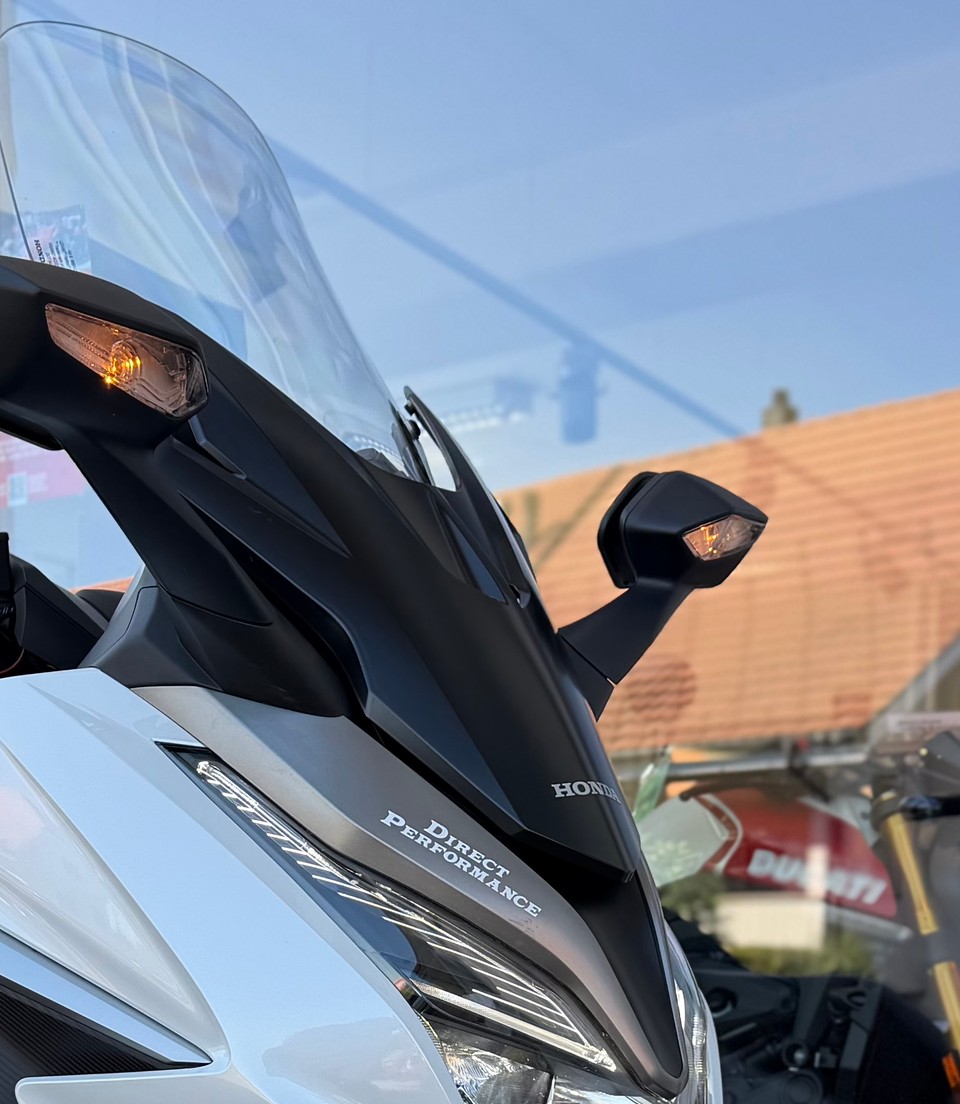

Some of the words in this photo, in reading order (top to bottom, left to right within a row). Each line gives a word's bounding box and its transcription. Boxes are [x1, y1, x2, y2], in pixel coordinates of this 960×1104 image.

[33, 239, 46, 263] HOND
[551, 780, 622, 805] HONDA
[380, 809, 542, 918] PERFORMANCE
[423, 819, 510, 879] DIRECT
